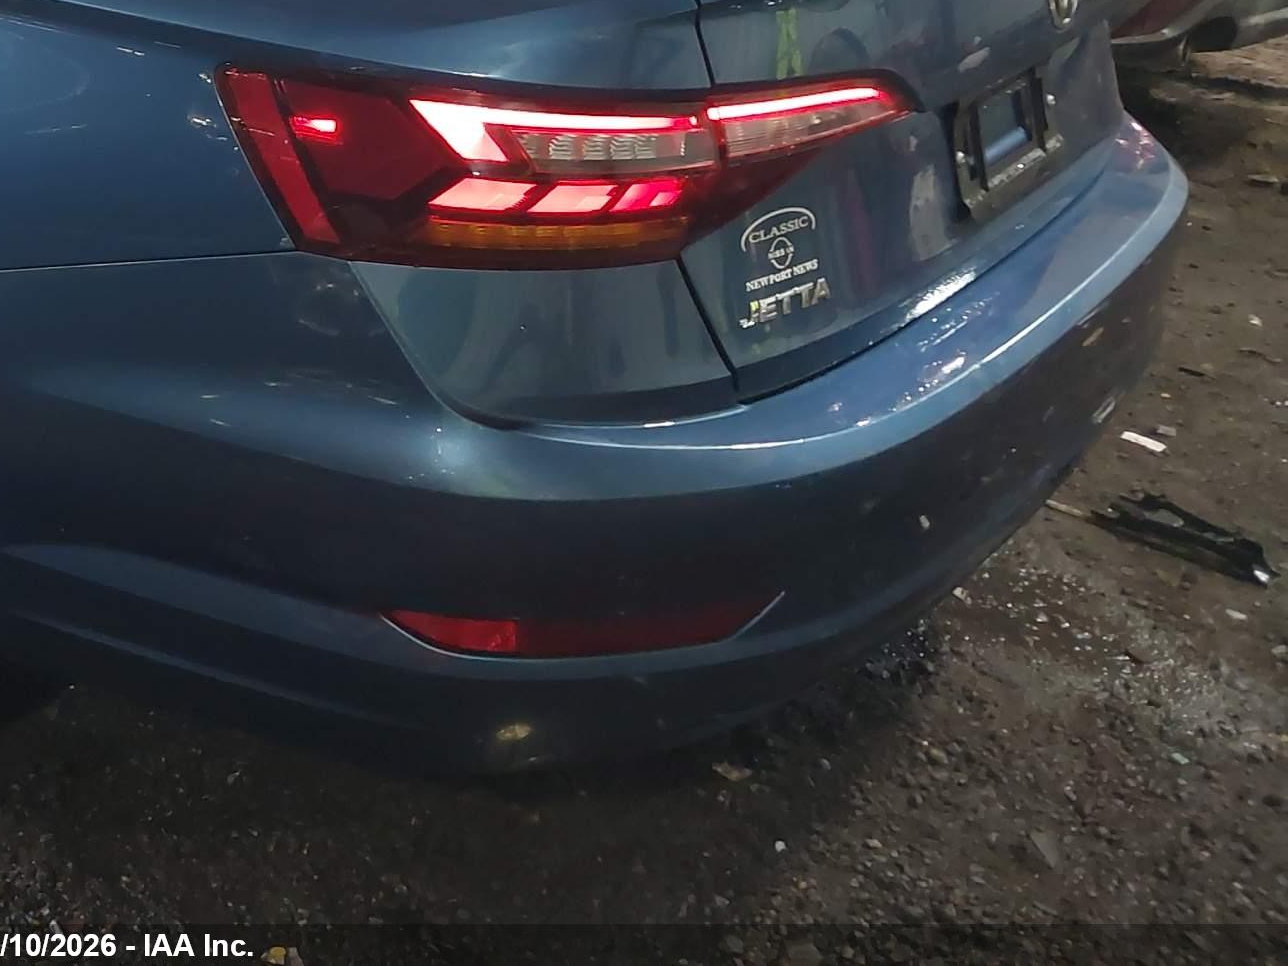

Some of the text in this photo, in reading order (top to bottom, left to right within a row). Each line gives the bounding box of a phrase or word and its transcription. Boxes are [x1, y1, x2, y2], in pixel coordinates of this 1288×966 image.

[748, 216, 809, 243] CLASSIC
[745, 259, 819, 292] NEWPORT NEWS
[739, 277, 831, 329] JETTA
